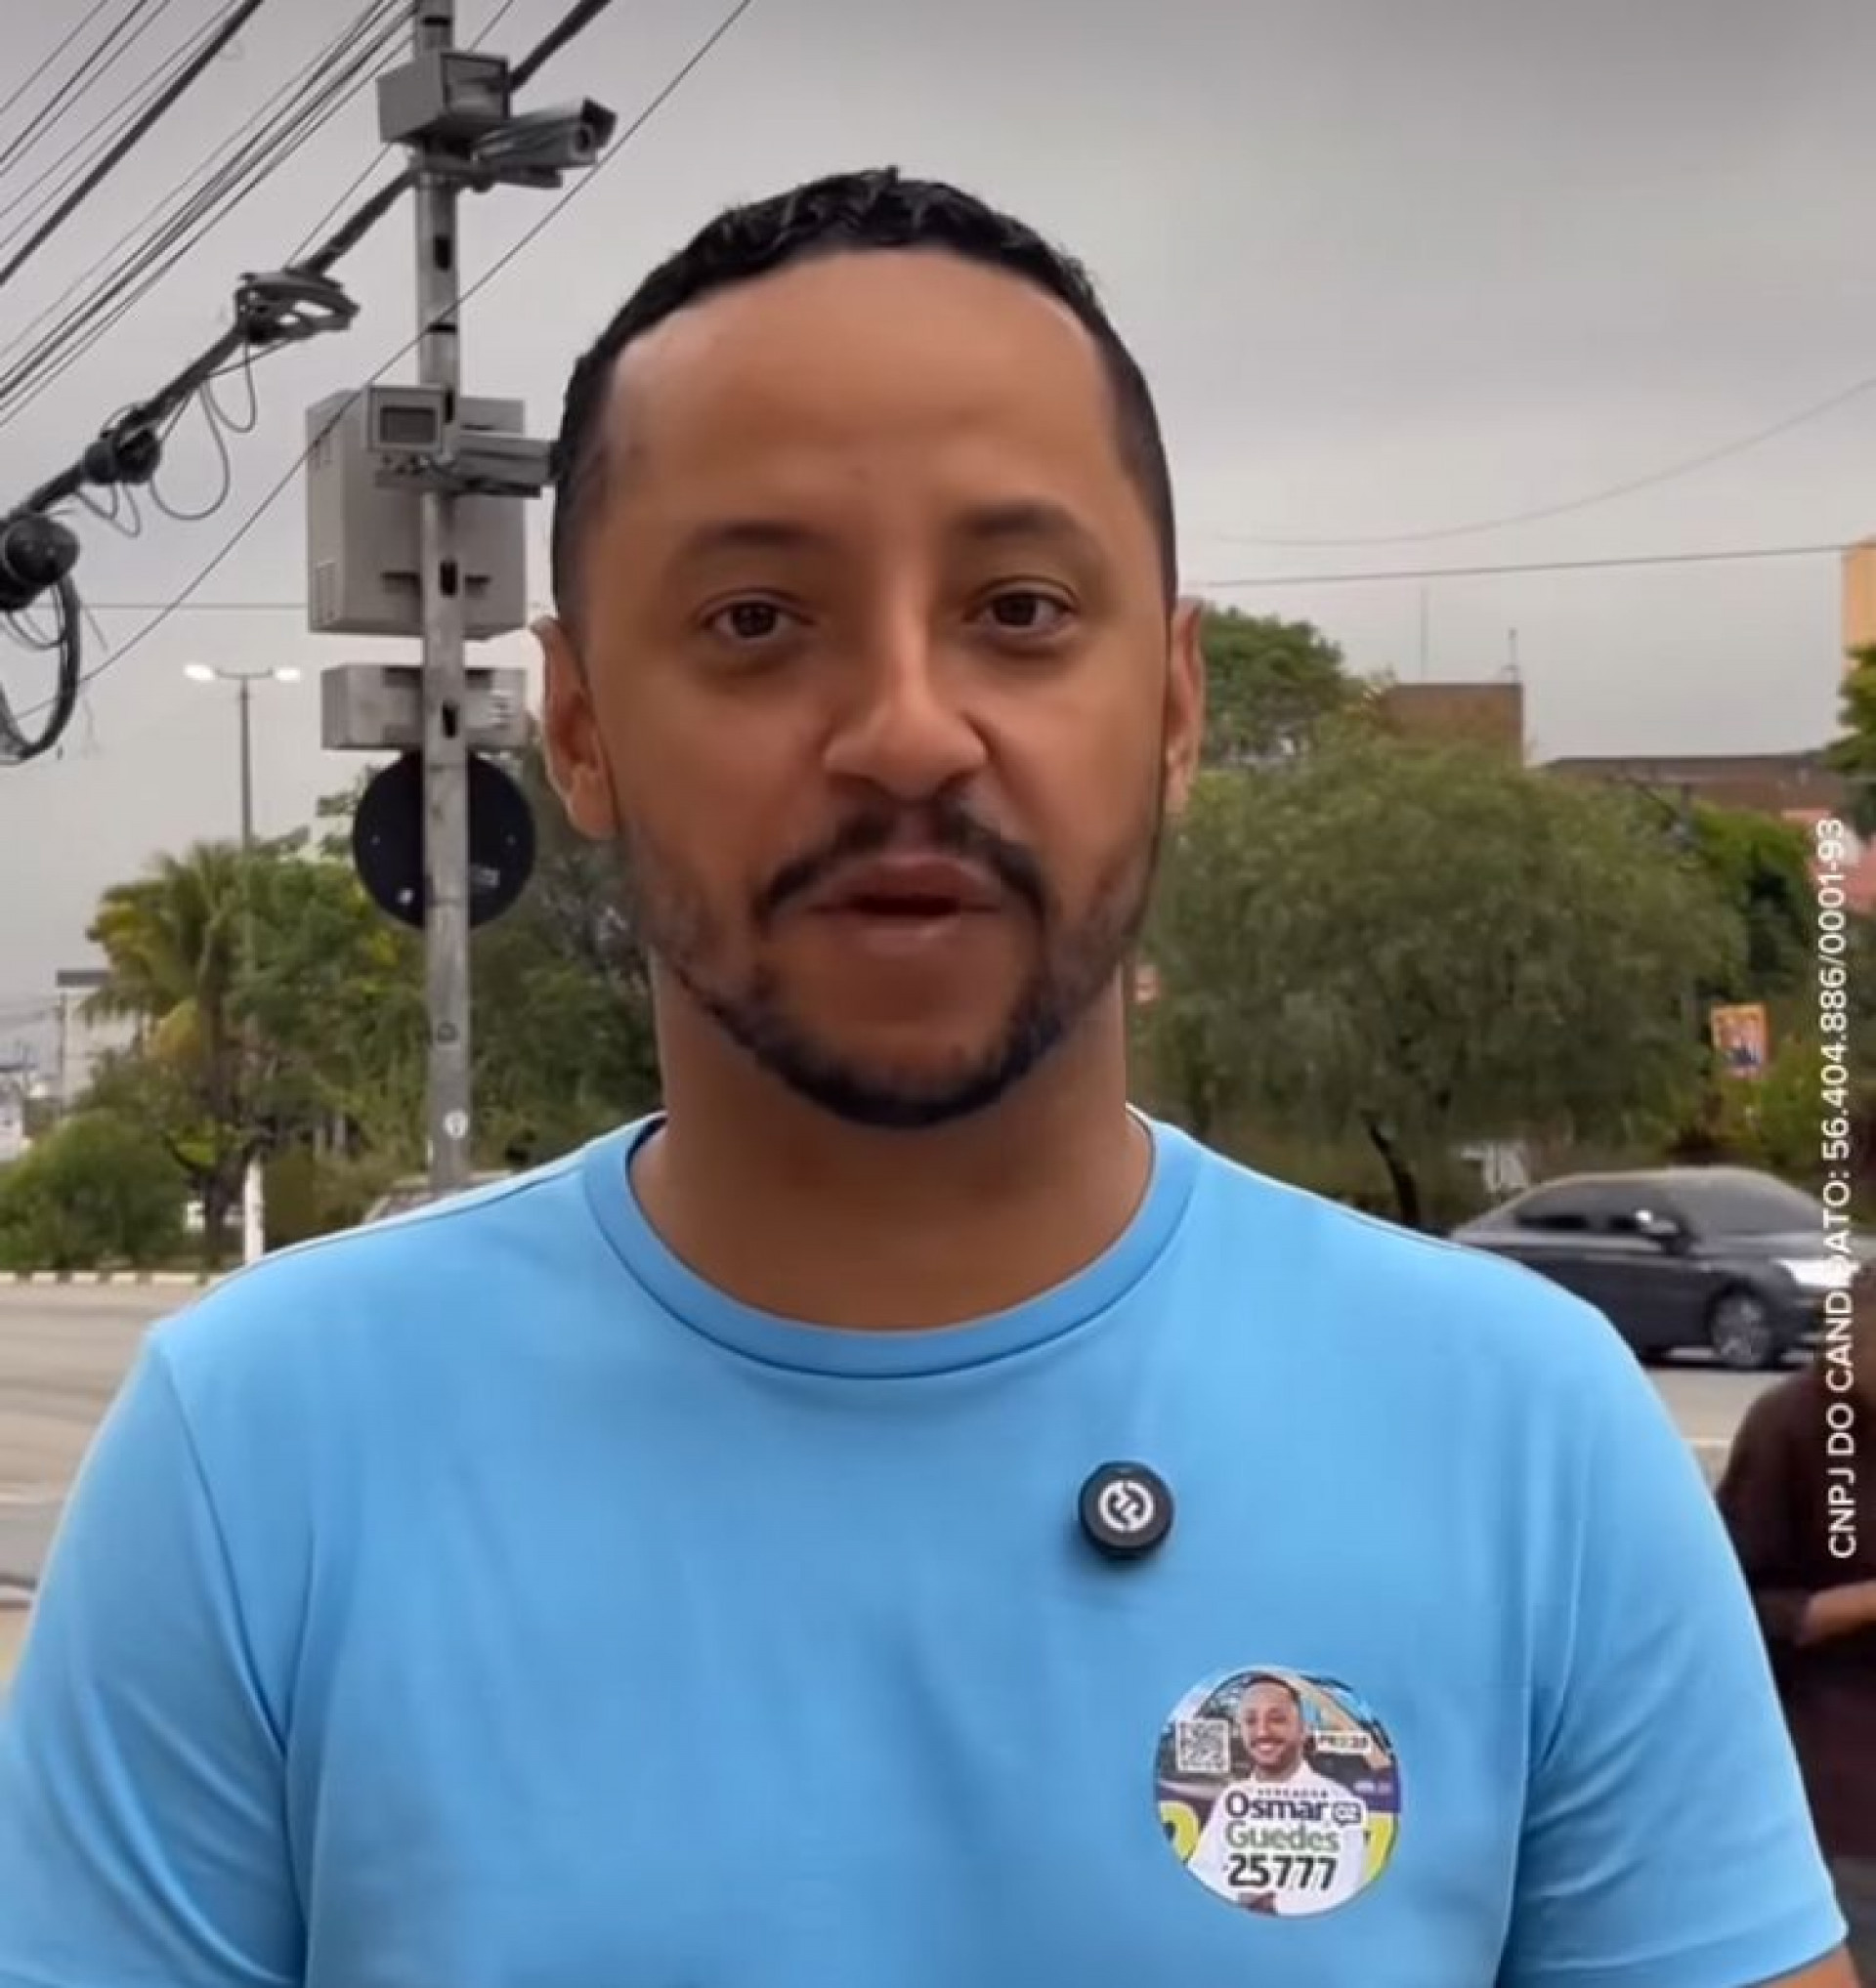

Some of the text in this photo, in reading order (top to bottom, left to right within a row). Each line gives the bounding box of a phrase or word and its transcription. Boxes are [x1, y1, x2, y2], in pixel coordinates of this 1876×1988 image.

[1224, 1790, 1329, 1820] Osmar
[1224, 1820, 1341, 1851] Guedes
[1227, 1852, 1338, 1890] 25777
